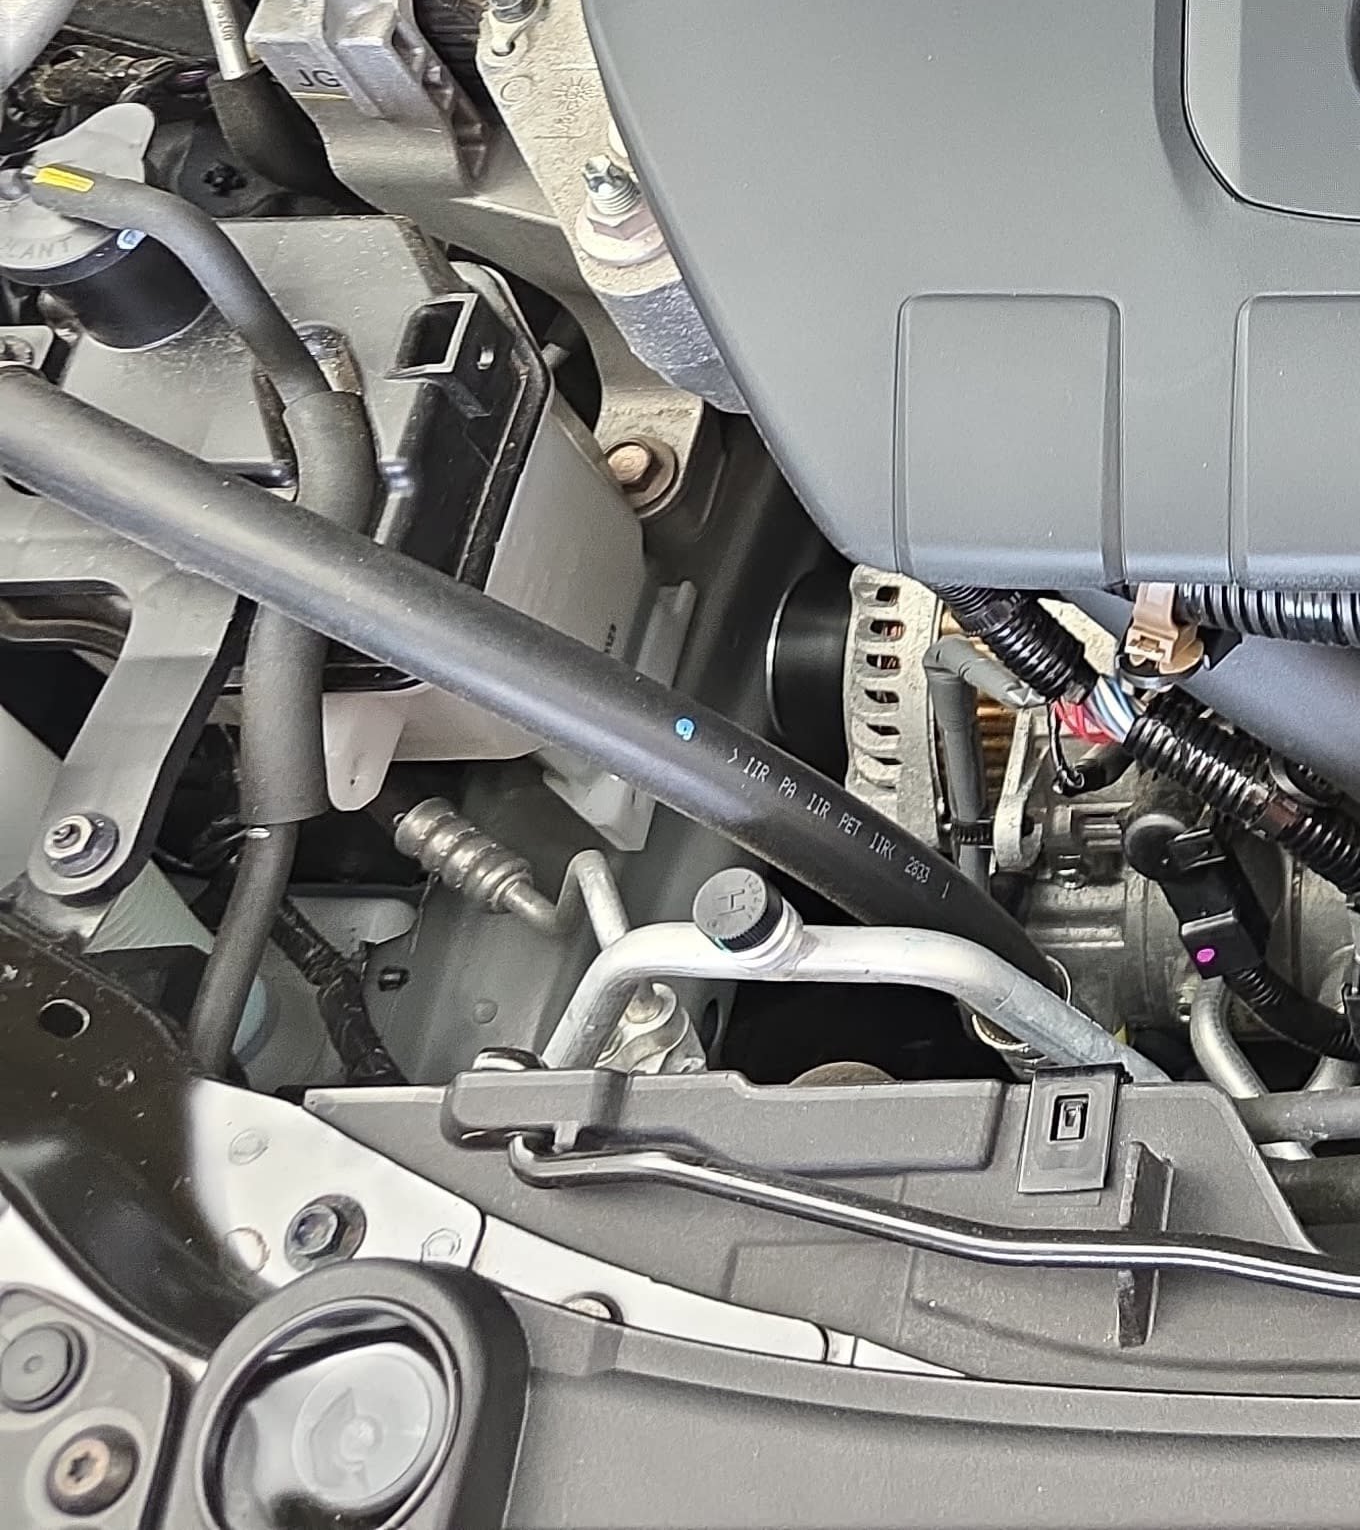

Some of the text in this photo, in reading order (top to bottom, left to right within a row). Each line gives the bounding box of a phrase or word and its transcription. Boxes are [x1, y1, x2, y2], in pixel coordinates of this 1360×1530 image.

[297, 68, 343, 88] JG
[778, 775, 798, 800] PA
[838, 812, 862, 836] PET
